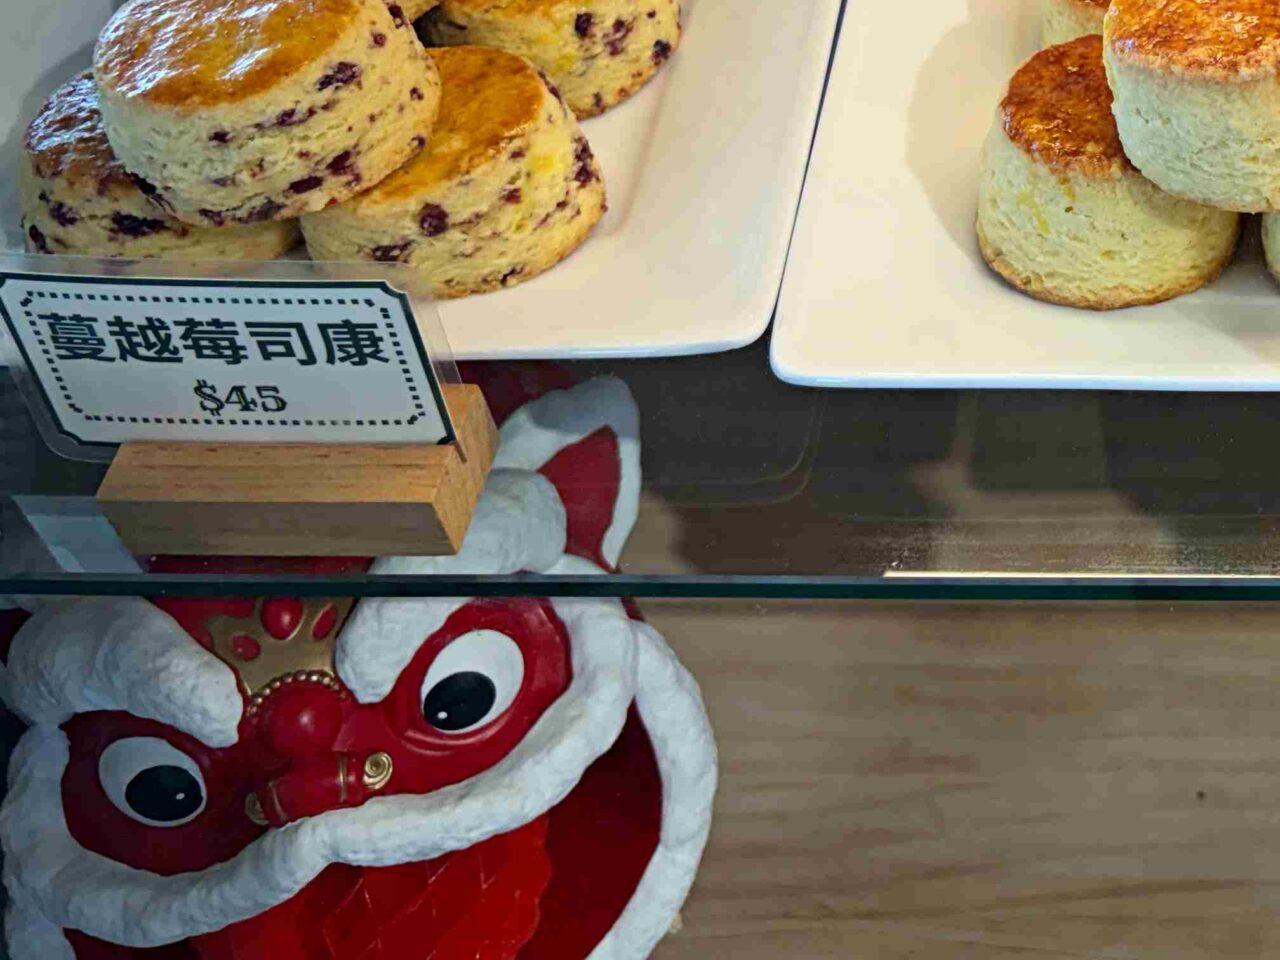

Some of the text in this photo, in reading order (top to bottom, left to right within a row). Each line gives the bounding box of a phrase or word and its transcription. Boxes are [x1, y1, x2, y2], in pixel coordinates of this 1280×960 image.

[38, 312, 391, 366] 蔓越莓司康
[193, 379, 288, 415] $45
